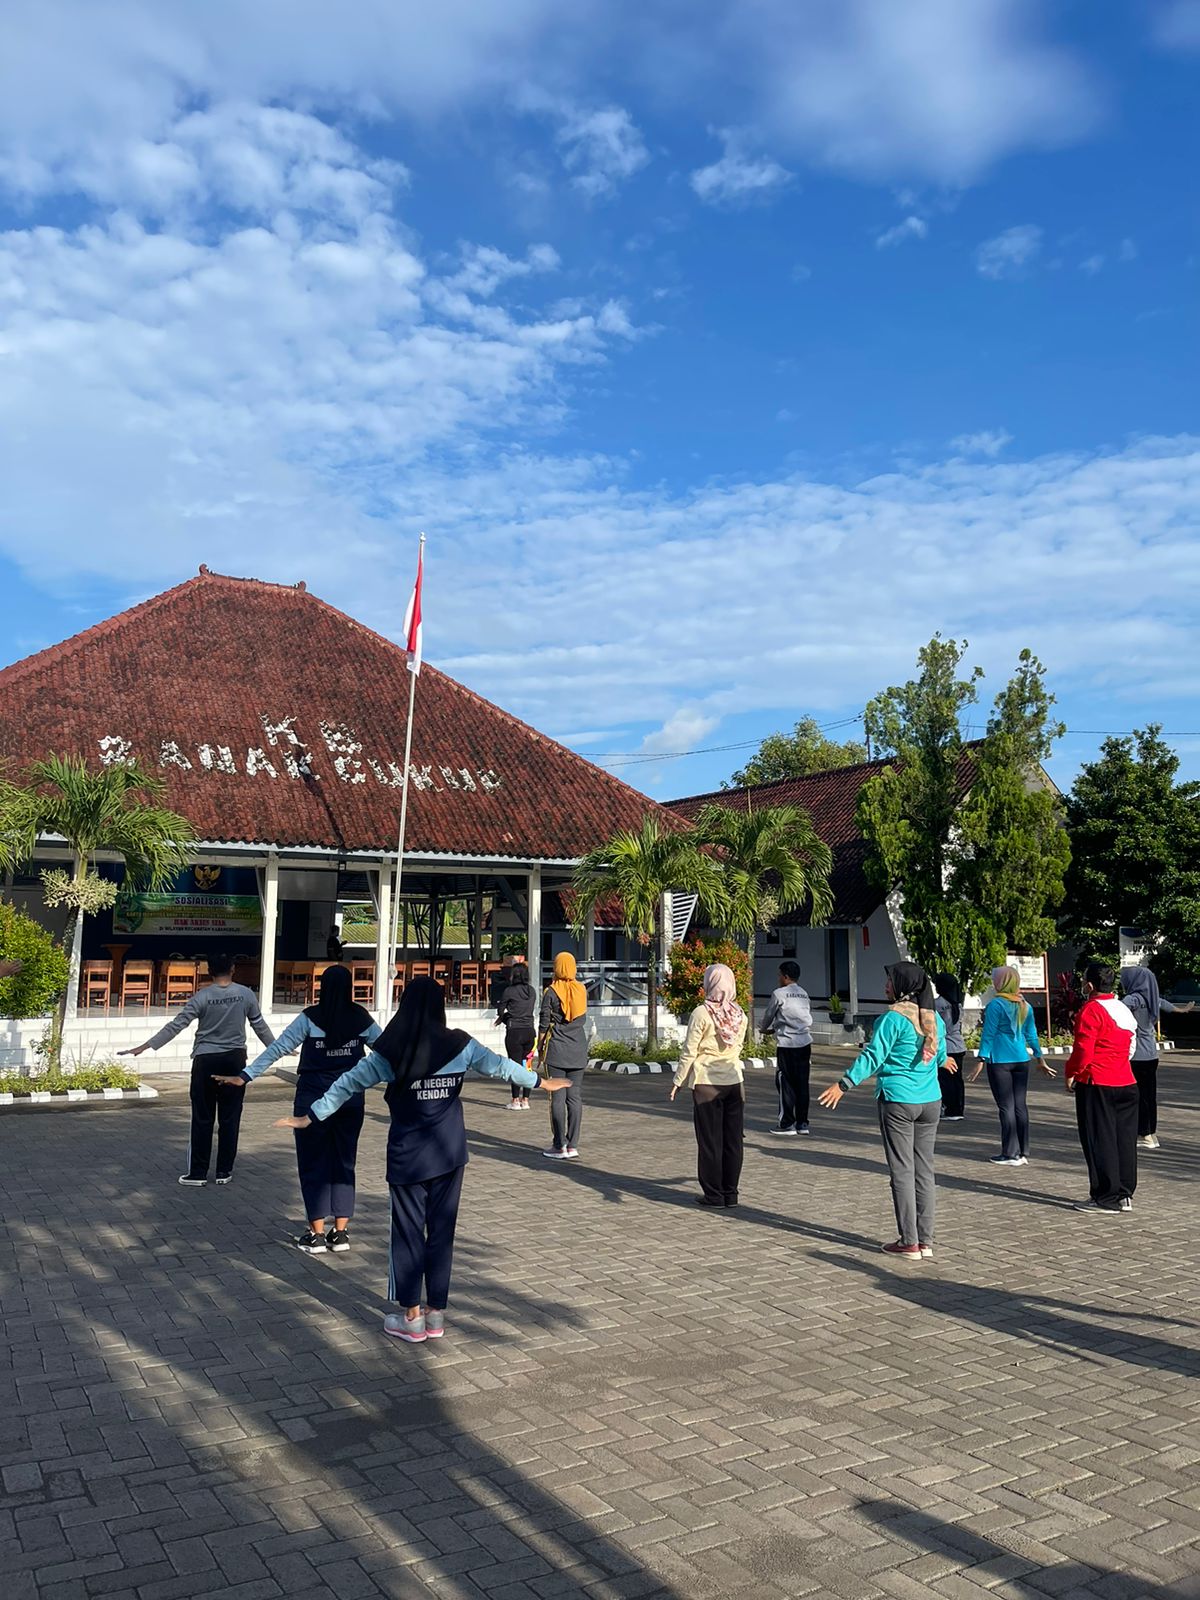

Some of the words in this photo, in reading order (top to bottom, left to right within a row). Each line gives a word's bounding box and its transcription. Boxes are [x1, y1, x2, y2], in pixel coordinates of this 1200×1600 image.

[175, 896, 228, 905] SOSIALISASI
[326, 1048, 353, 1057] KENDAL
[409, 1079, 422, 1090] MK
[424, 1077, 456, 1089] NEGERI
[416, 1088, 450, 1100] KENDAL
